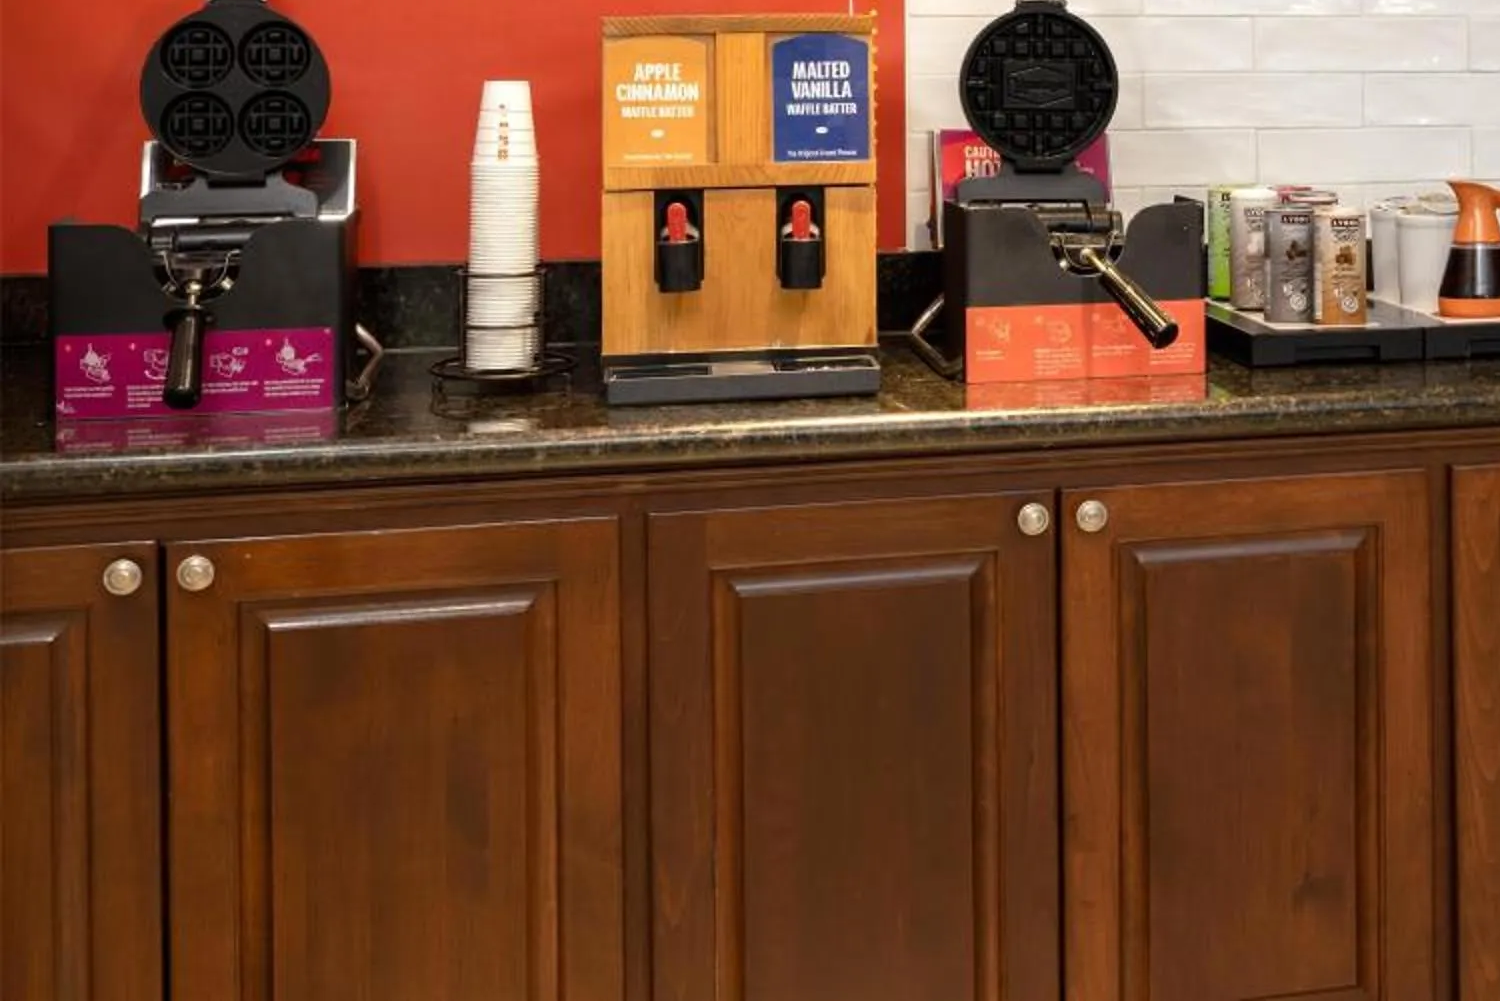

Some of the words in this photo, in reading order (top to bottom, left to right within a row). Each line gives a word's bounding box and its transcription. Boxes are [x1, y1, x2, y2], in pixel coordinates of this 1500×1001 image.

[634, 62, 682, 81] APPLE
[792, 61, 851, 79] MALTED
[616, 82, 699, 102] CINNAMON
[791, 81, 852, 99] VANILLA
[786, 103, 820, 115] WAFFLE
[823, 102, 857, 115] BATTER
[964, 145, 1001, 158] CAUTI
